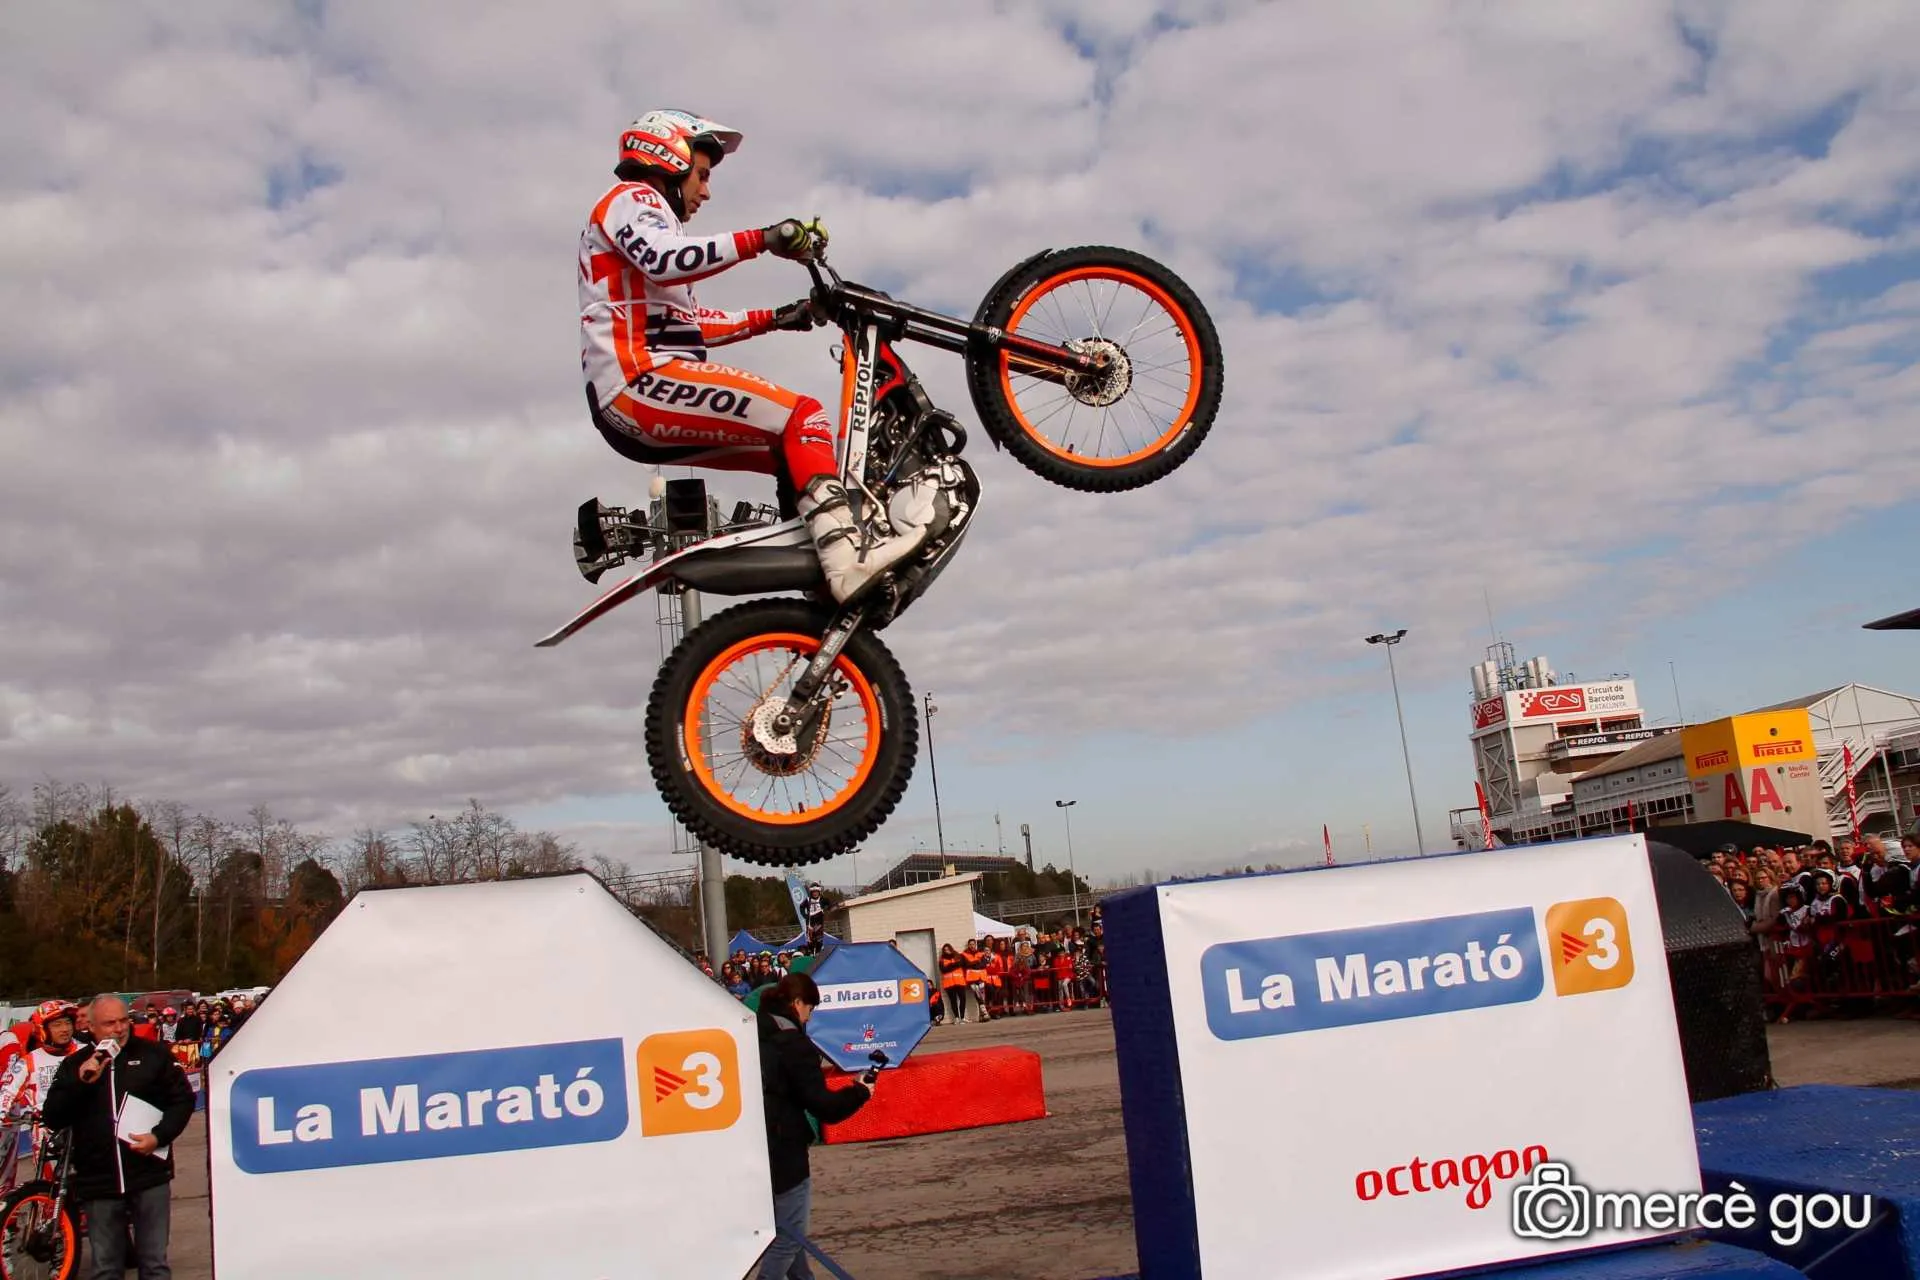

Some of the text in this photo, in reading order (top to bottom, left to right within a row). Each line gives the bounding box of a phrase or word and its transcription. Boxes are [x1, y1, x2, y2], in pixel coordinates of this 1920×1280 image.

[626, 135, 690, 171] hebo
[615, 223, 724, 275] REPSOL
[630, 374, 753, 419] REPSOL
[853, 361, 872, 433] REPSOL
[651, 423, 767, 446] Montesa
[1588, 684, 1624, 695] Circuit de
[1588, 694, 1625, 703] Barcelona
[1577, 735, 1608, 746] REPSOL
[1624, 731, 1655, 741] REPSOL
[1753, 739, 1804, 758] PIRELLI
[1696, 750, 1730, 770] PIRELLI
[1725, 772, 1749, 818] A
[1750, 767, 1785, 814] A
[1225, 918, 1620, 1014] La Marató 3
[837, 986, 893, 1003] Marató
[257, 1051, 725, 1146] La Marató 3
[1355, 1144, 1549, 1209] octagon
